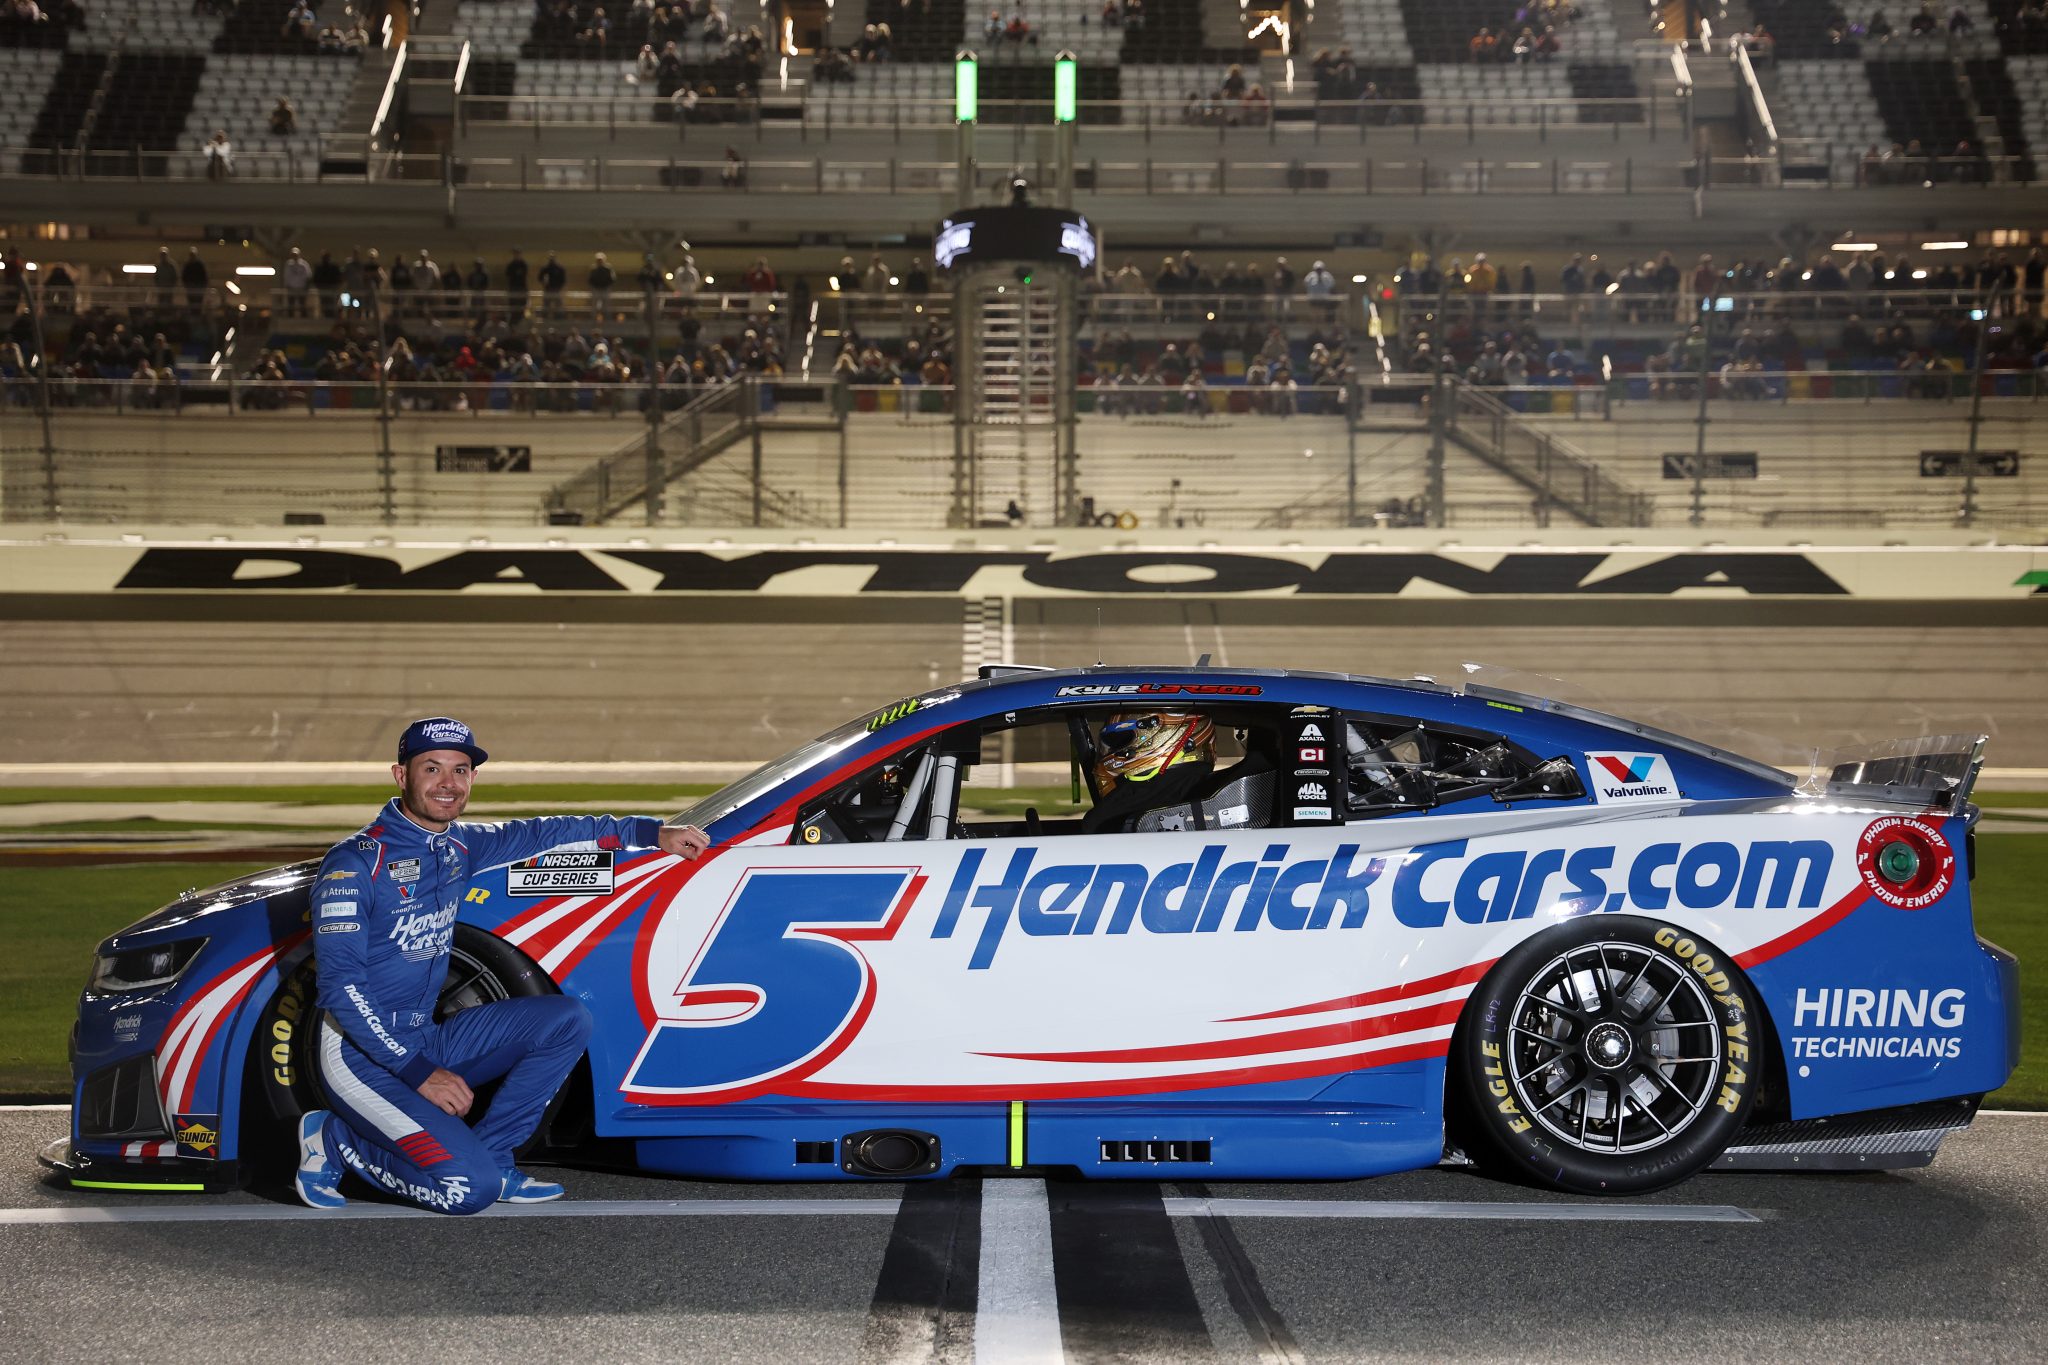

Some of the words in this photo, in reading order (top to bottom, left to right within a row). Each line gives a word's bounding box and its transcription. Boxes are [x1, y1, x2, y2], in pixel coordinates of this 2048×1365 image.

[115, 548, 1852, 595] DAYTONA
[422, 722, 470, 737] Hendrick
[1300, 748, 1324, 761] CI
[1297, 782, 1327, 795] MAC
[1603, 785, 1667, 798] Valvoline
[1903, 818, 1947, 848] ENERGY
[541, 854, 599, 867] NASCAR
[522, 872, 551, 886] CUP
[551, 872, 599, 885] SERIES
[328, 886, 359, 897] Atrium
[1905, 874, 1949, 908] ENERGY
[324, 906, 353, 914] SIEMENS
[619, 865, 926, 1100] 5
[1793, 987, 1967, 1028] HIRING
[113, 1013, 143, 1034] Hendrick
[1654, 927, 1749, 1114] GOODYEAR
[1791, 1036, 1962, 1059] TECHNICIANS
[1481, 1039, 1533, 1134] EAGLE
